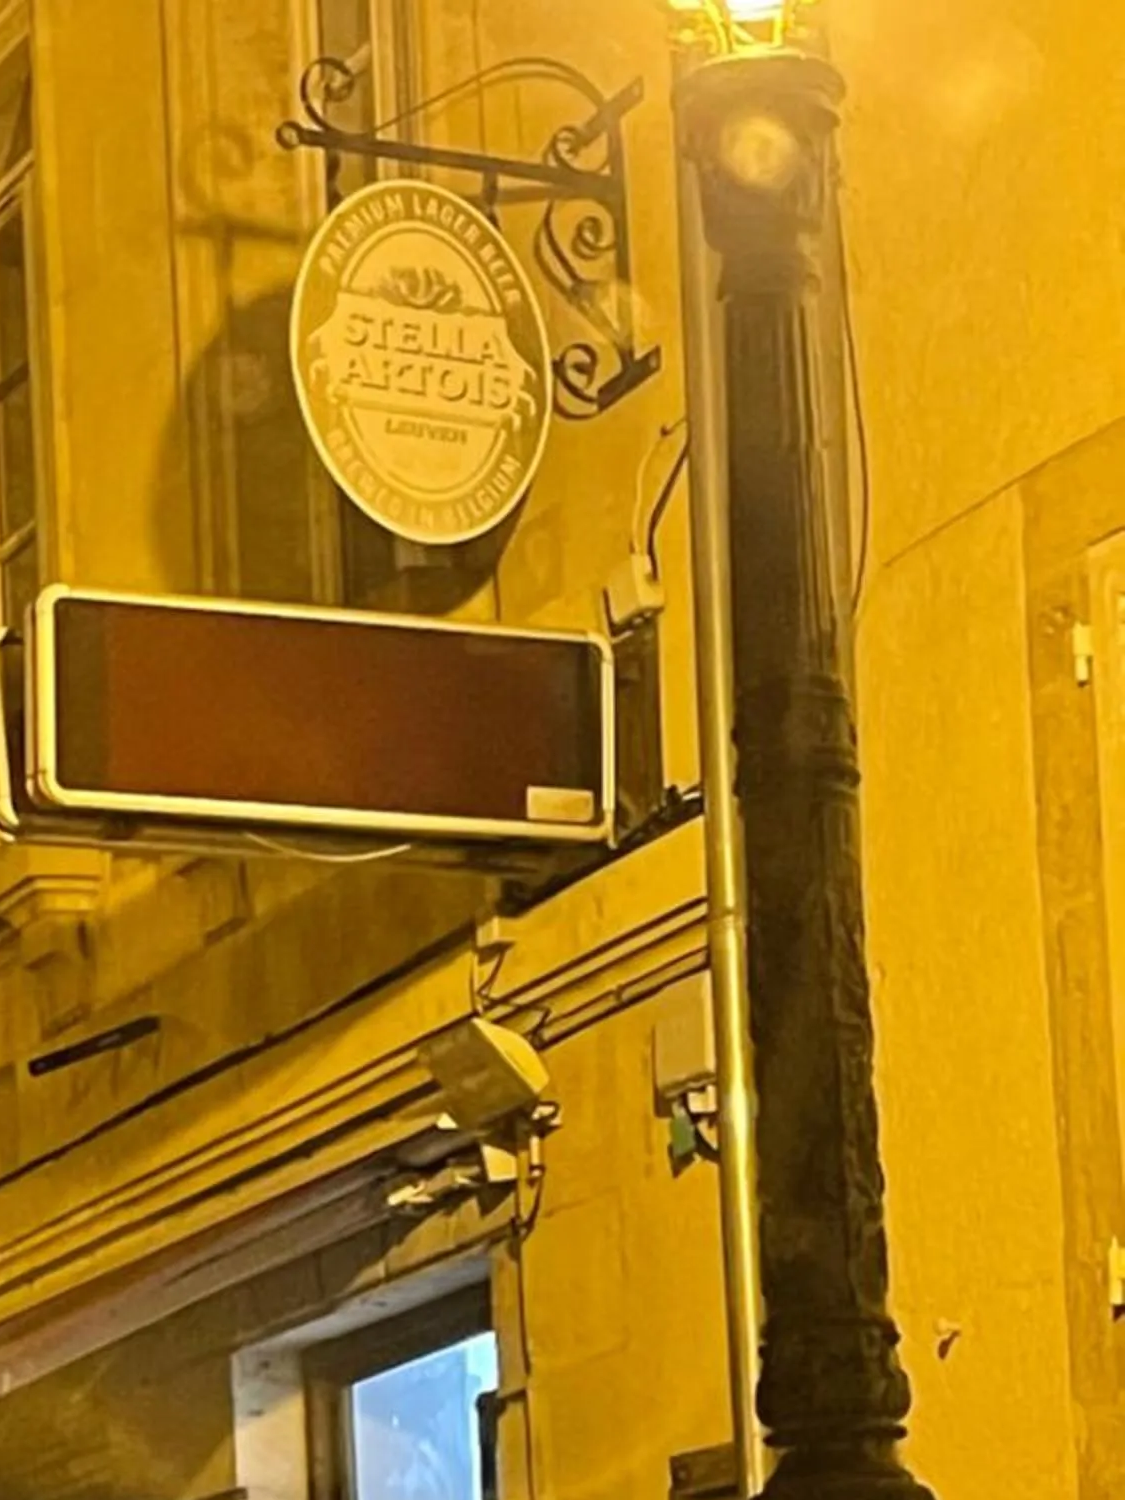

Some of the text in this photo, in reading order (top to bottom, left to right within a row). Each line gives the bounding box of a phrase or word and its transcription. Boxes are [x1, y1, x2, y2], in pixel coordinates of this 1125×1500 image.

[320, 193, 405, 277] PREMIUM
[411, 193, 481, 241] LAGER
[343, 312, 503, 366] STELLA
[341, 353, 515, 412] ARTOIS
